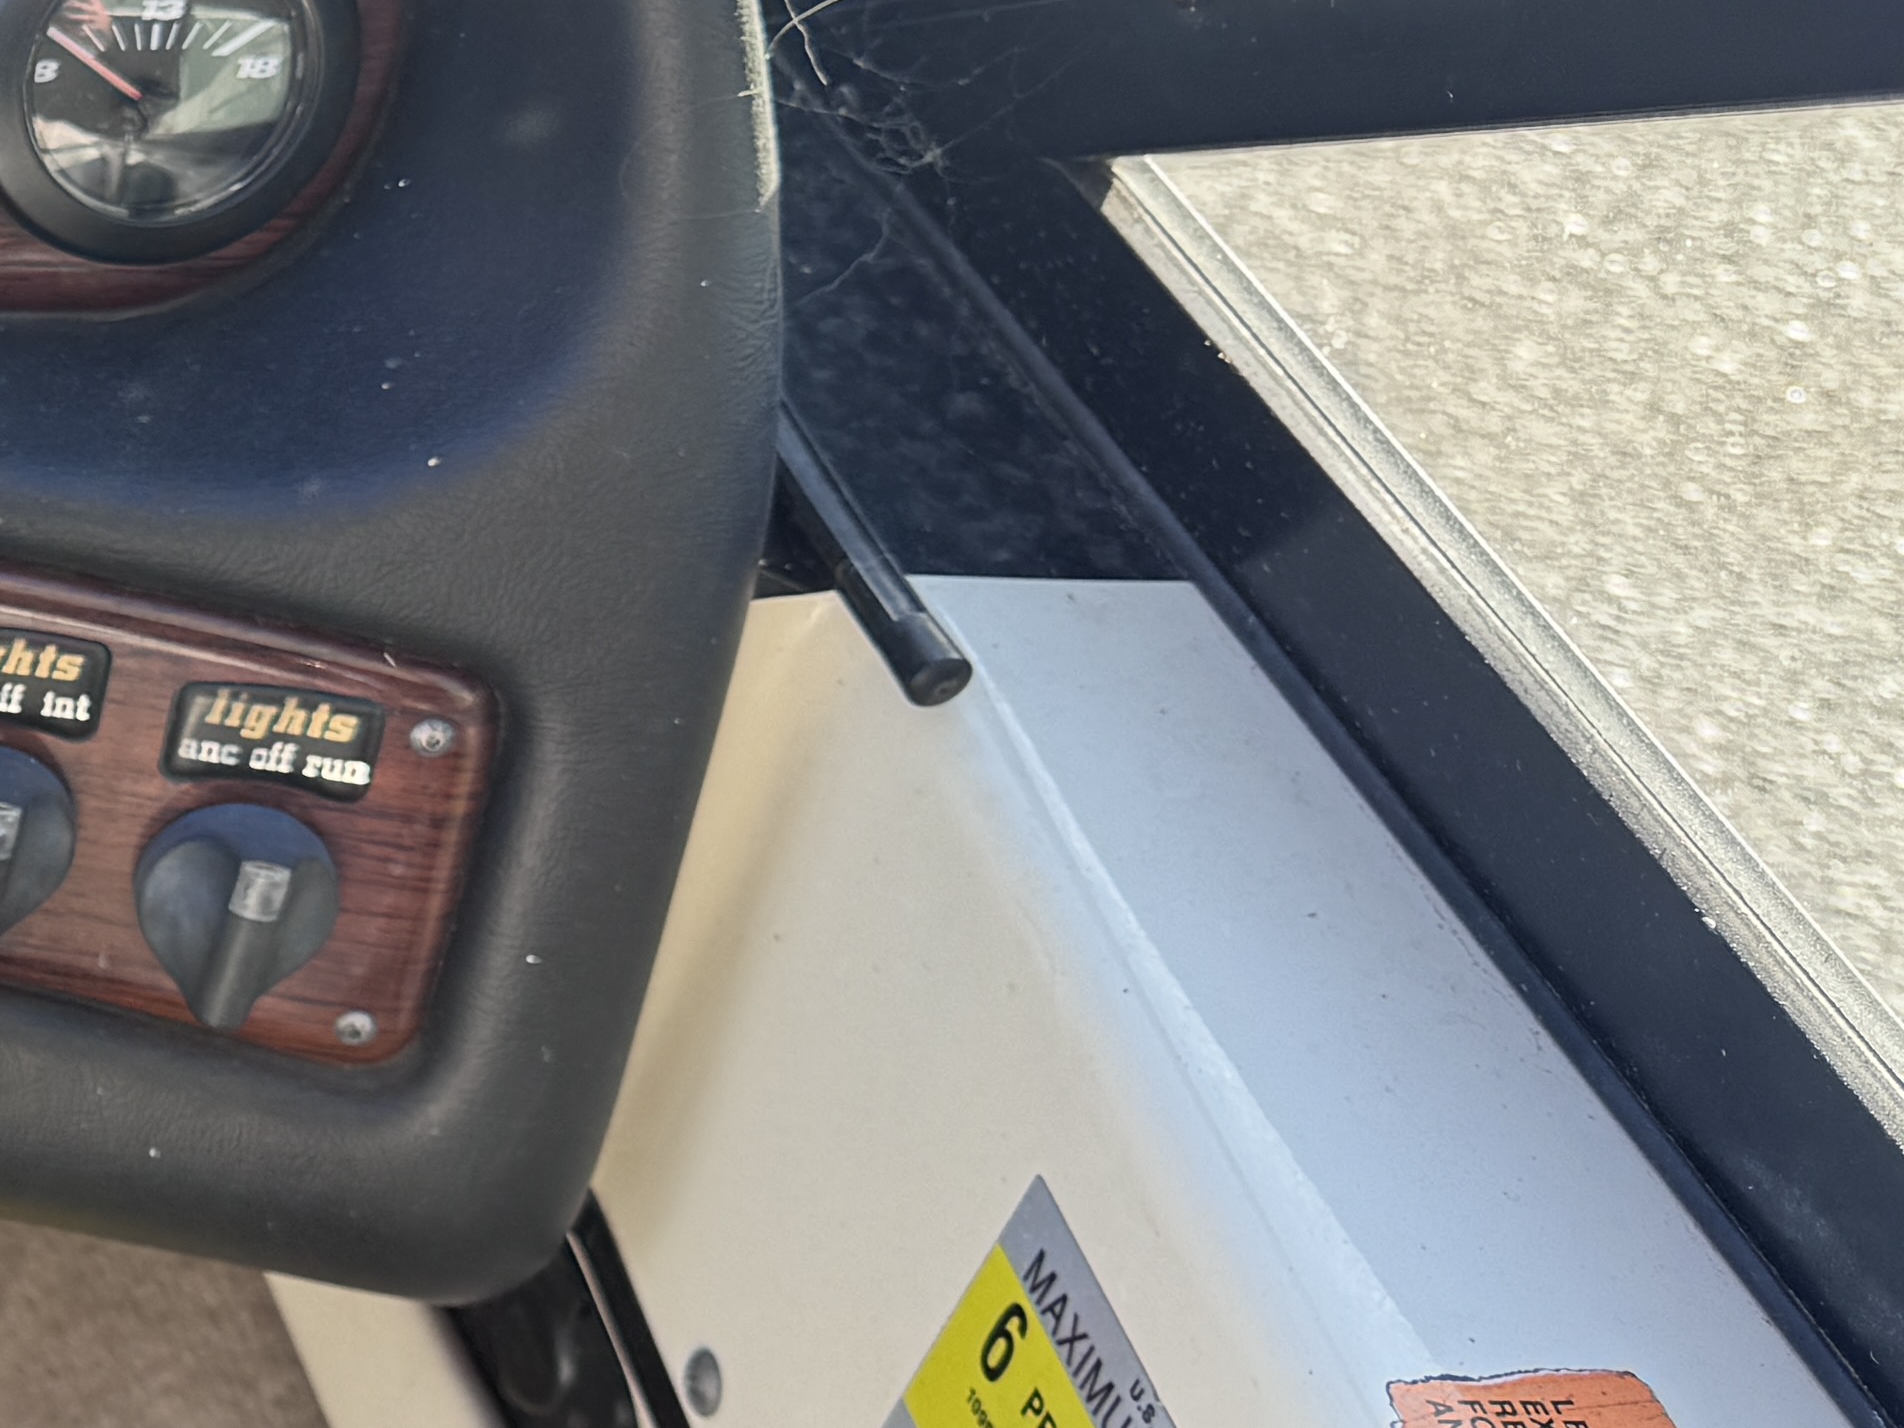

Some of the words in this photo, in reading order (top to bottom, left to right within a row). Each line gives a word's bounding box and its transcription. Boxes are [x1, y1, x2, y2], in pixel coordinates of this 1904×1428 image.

[42, 694, 90, 721] int
[205, 690, 359, 742] lights
[178, 739, 241, 764] anc
[248, 745, 294, 774] off
[302, 751, 371, 786] run
[974, 1291, 1032, 1391] 6
